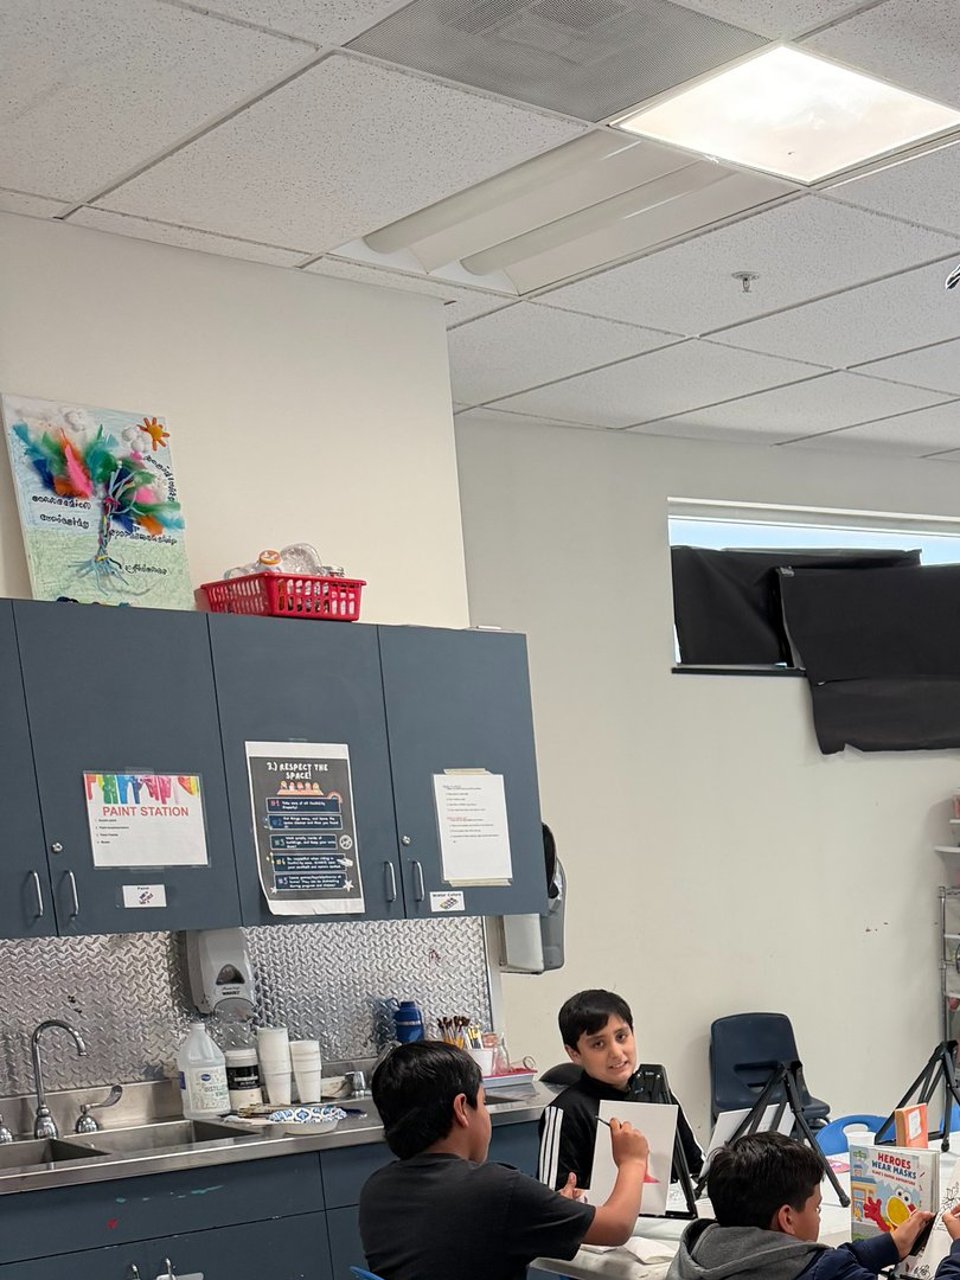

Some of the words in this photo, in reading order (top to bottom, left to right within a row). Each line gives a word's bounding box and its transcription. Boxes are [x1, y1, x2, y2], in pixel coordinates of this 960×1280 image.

[279, 762, 311, 772] RESPECT
[314, 763, 328, 772] THE
[102, 806, 137, 817] PAINT
[140, 806, 189, 817] STATION
[877, 1152, 912, 1170] HEROES
[871, 1160, 892, 1173] WEAR
[892, 1165, 917, 1180] MASKS
